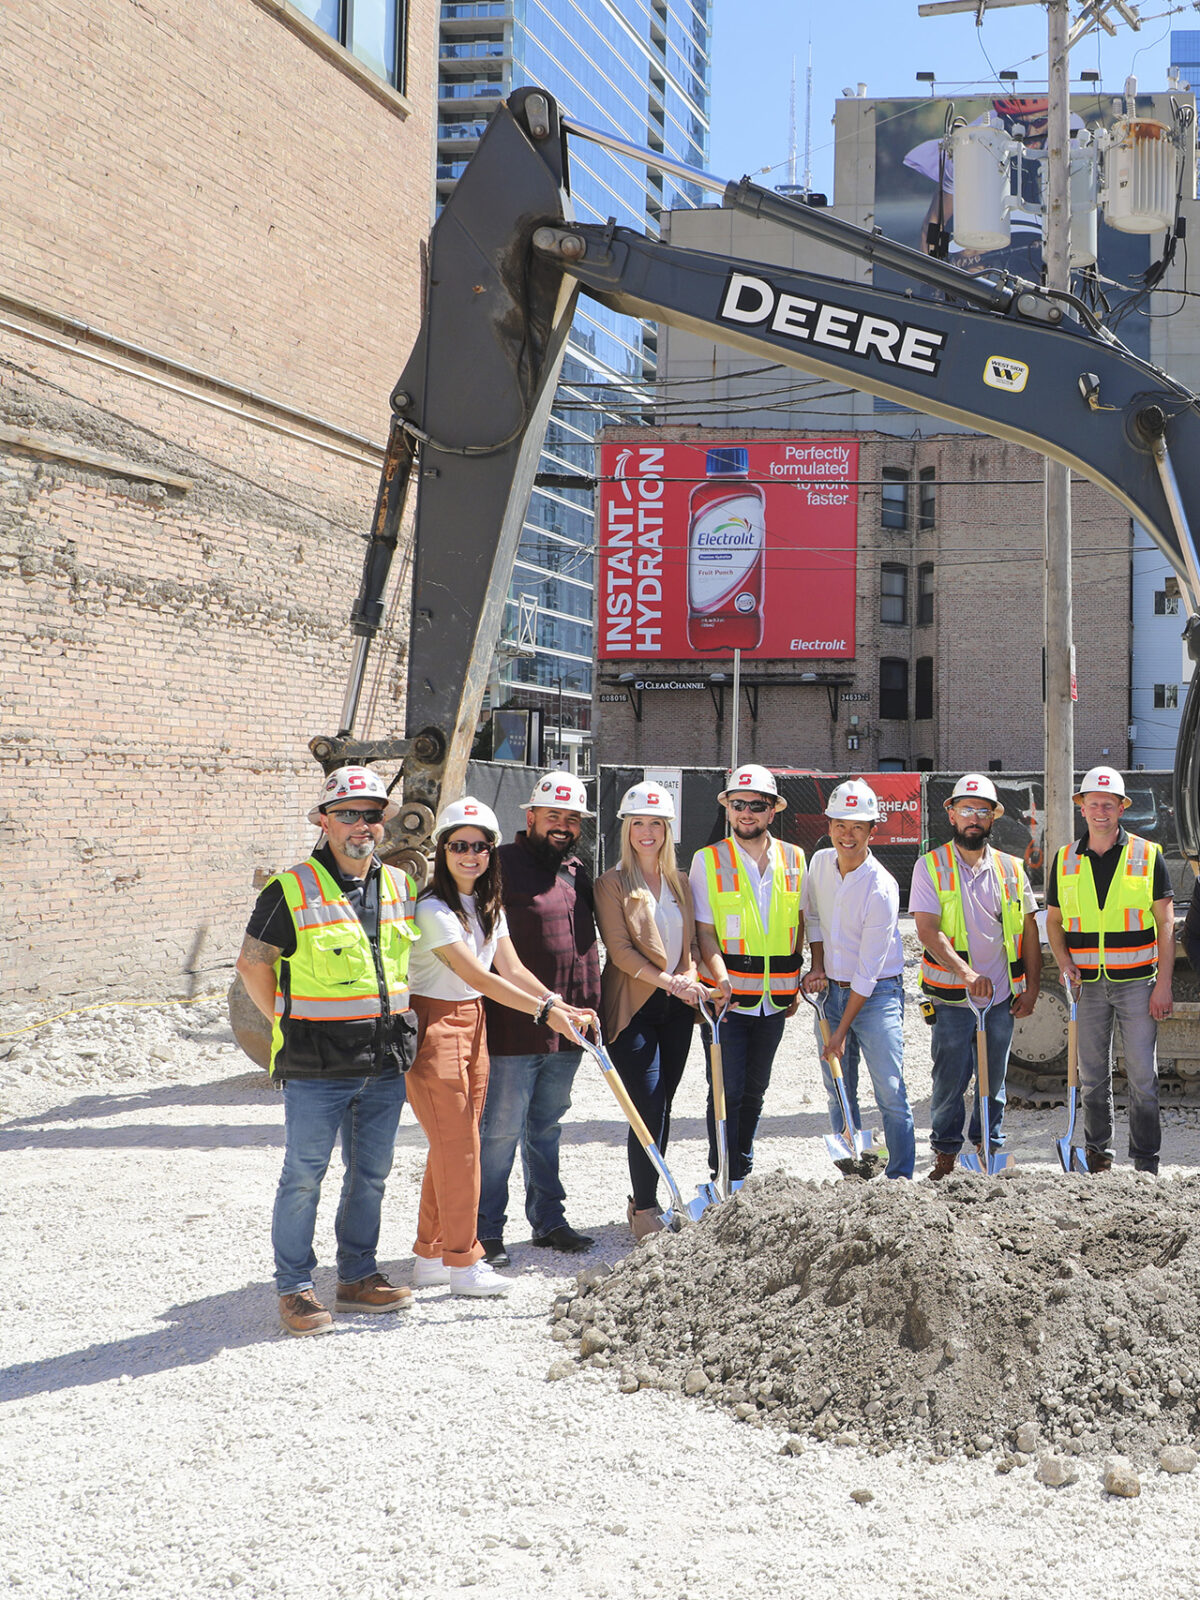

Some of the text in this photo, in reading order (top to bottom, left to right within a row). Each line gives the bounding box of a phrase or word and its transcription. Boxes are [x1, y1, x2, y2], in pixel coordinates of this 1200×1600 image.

[721, 272, 943, 373] DEERE
[991, 360, 1009, 368] WEST
[785, 446, 850, 462] Perfectly
[769, 461, 849, 475] formulated
[796, 476, 849, 490] to work
[807, 491, 849, 505] faster
[697, 532, 755, 546] Electrolit
[636, 447, 664, 651] HYDRATION
[606, 500, 634, 651] INSTANT
[789, 639, 848, 650] Electrolit
[663, 780, 680, 789] GATE
[878, 800, 918, 812] RHEAD
